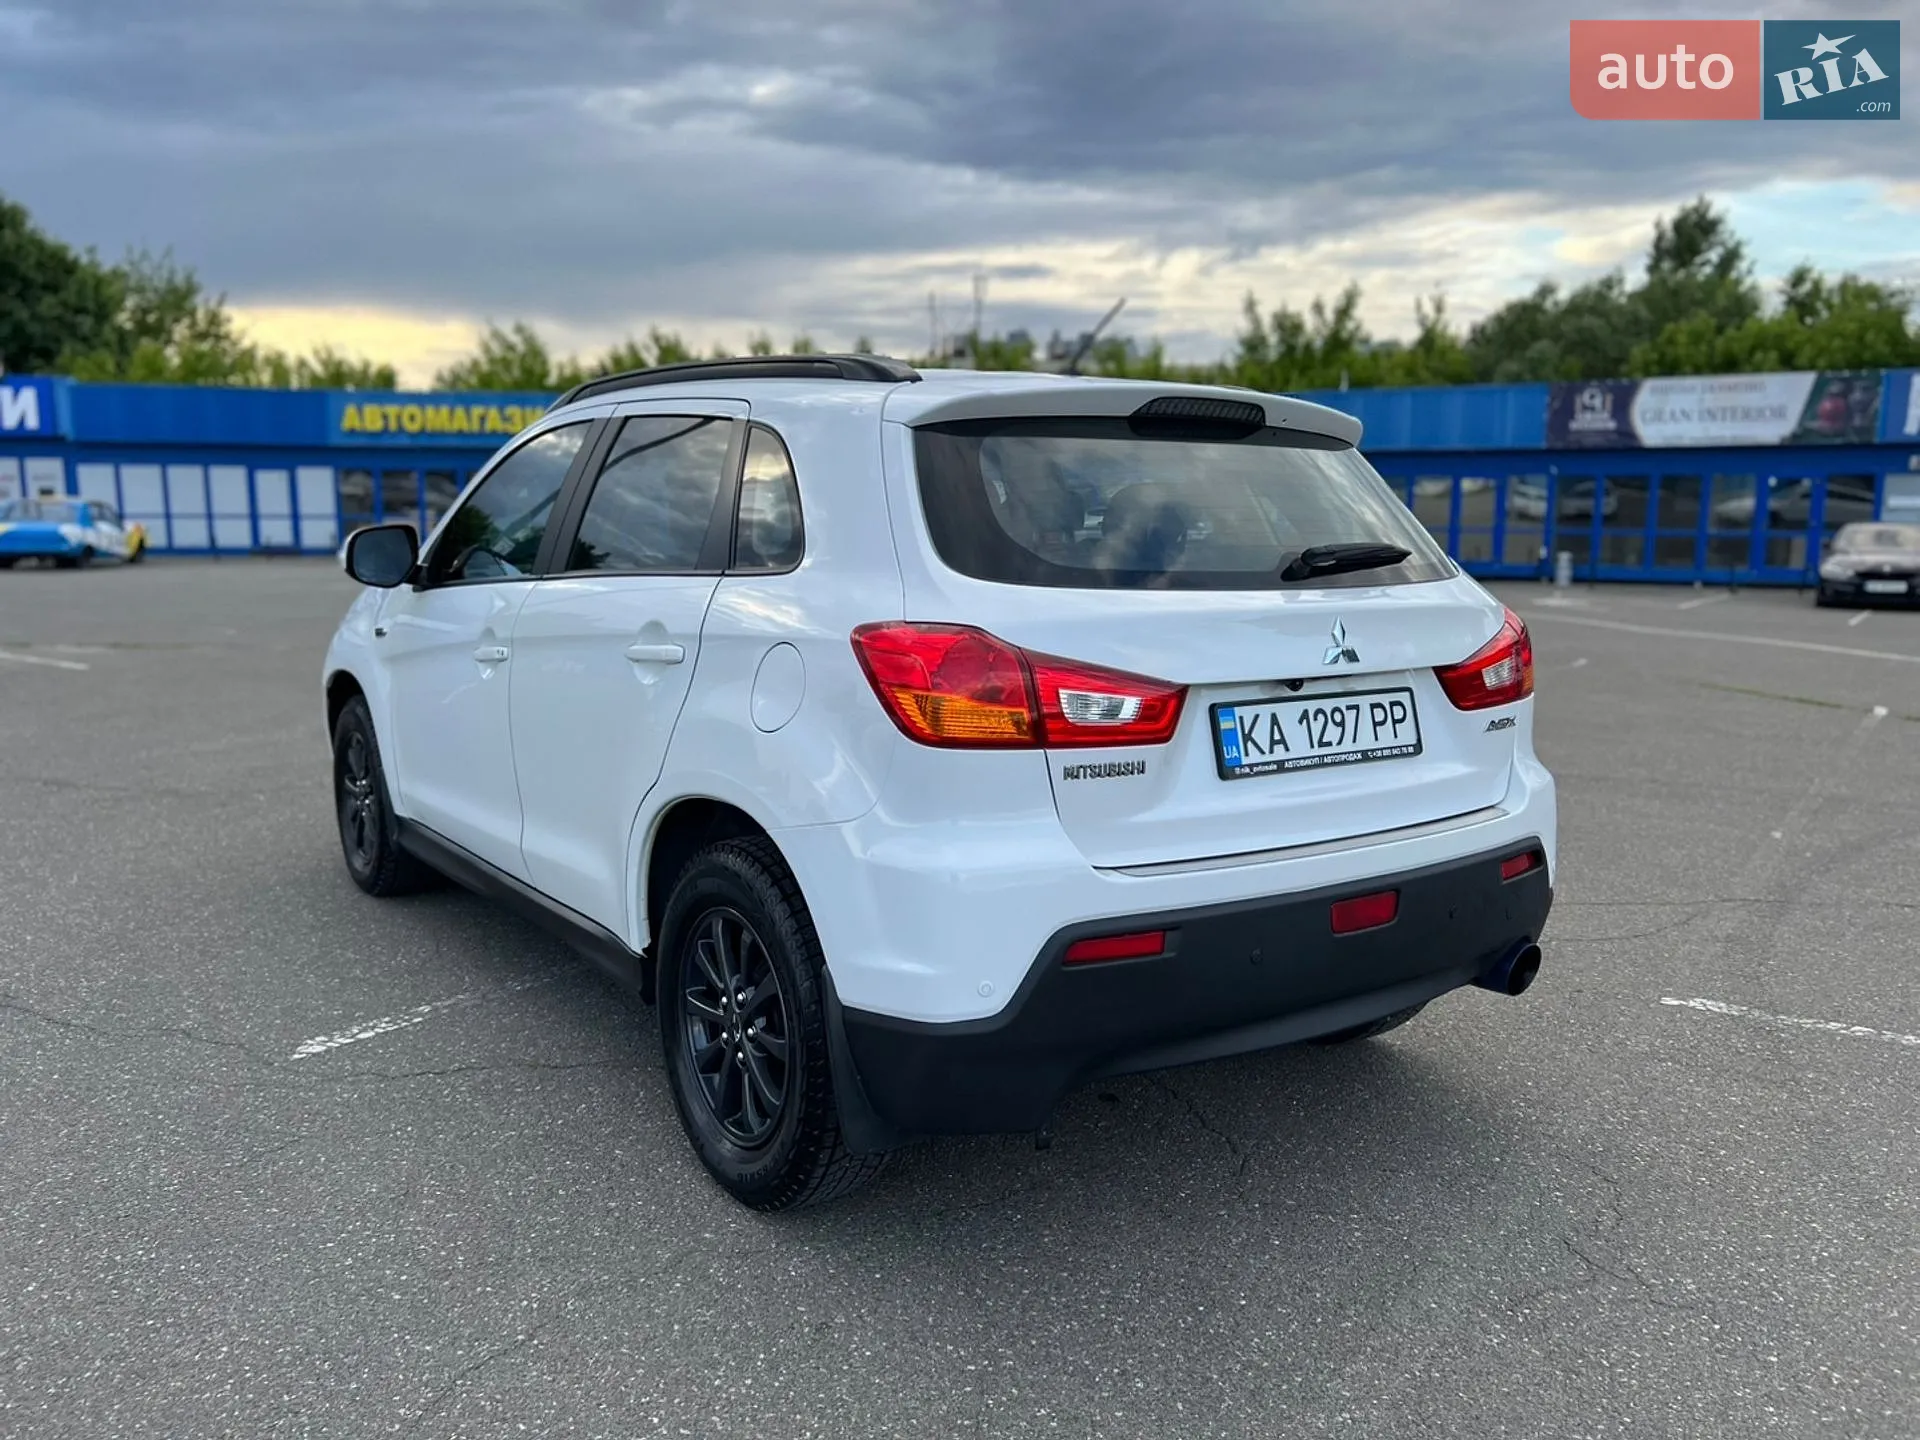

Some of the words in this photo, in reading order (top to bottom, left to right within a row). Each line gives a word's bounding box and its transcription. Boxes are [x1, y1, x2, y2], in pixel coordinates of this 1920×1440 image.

[1238, 711, 1290, 757] KA
[1297, 703, 1361, 749] 1297
[1369, 699, 1408, 742] PP
[1224, 744, 1240, 760] UA
[1063, 760, 1146, 780] MITSUBISHI
